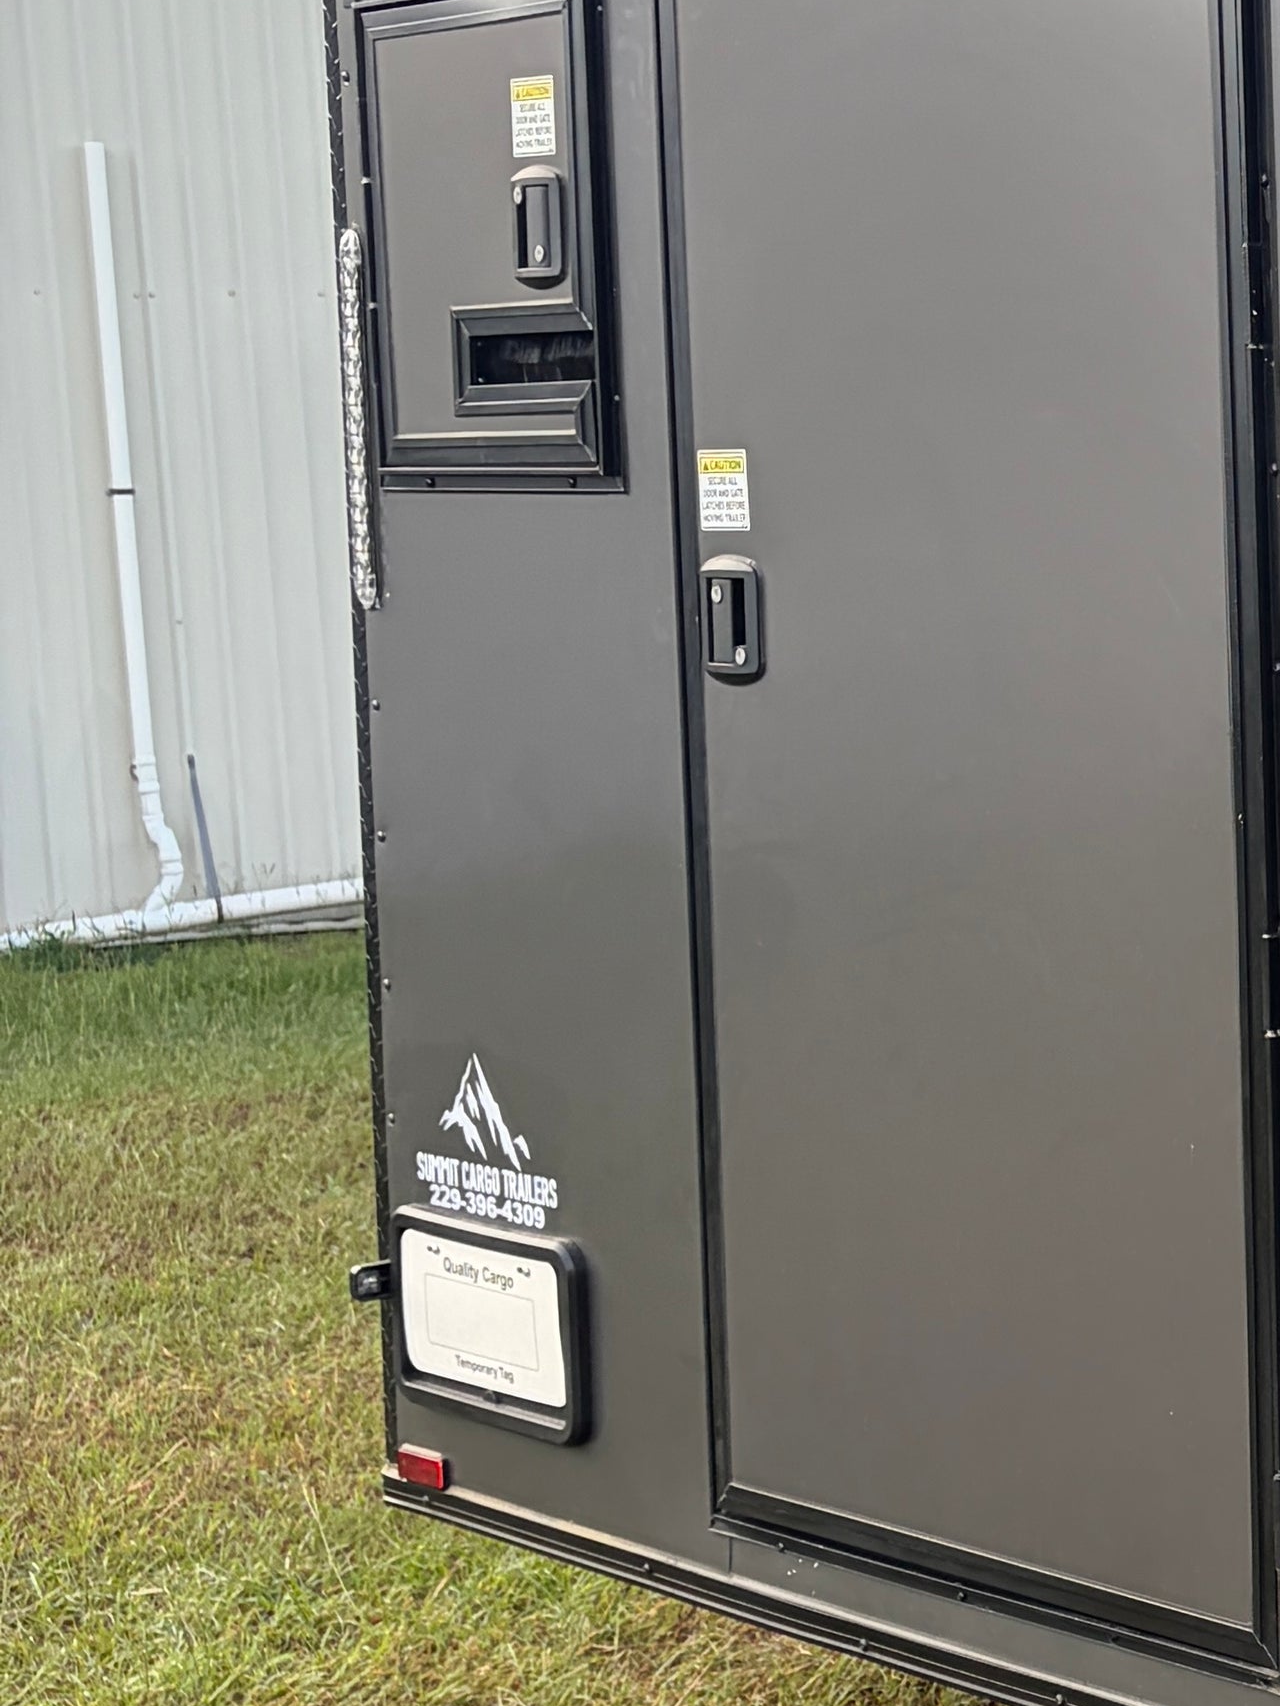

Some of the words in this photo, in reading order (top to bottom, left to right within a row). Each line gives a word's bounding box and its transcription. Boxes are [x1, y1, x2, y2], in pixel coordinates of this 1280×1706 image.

[710, 460, 741, 471] CAUTION
[416, 1151, 460, 1187] SUMMIT
[461, 1160, 501, 1197] CARGO
[501, 1169, 558, 1209] TRAILERS
[429, 1183, 546, 1230] 229-396-4309
[443, 1256, 480, 1284] Quality
[482, 1266, 514, 1291] Cargo
[454, 1353, 498, 1380] Temporary
[498, 1366, 515, 1384] Tag
